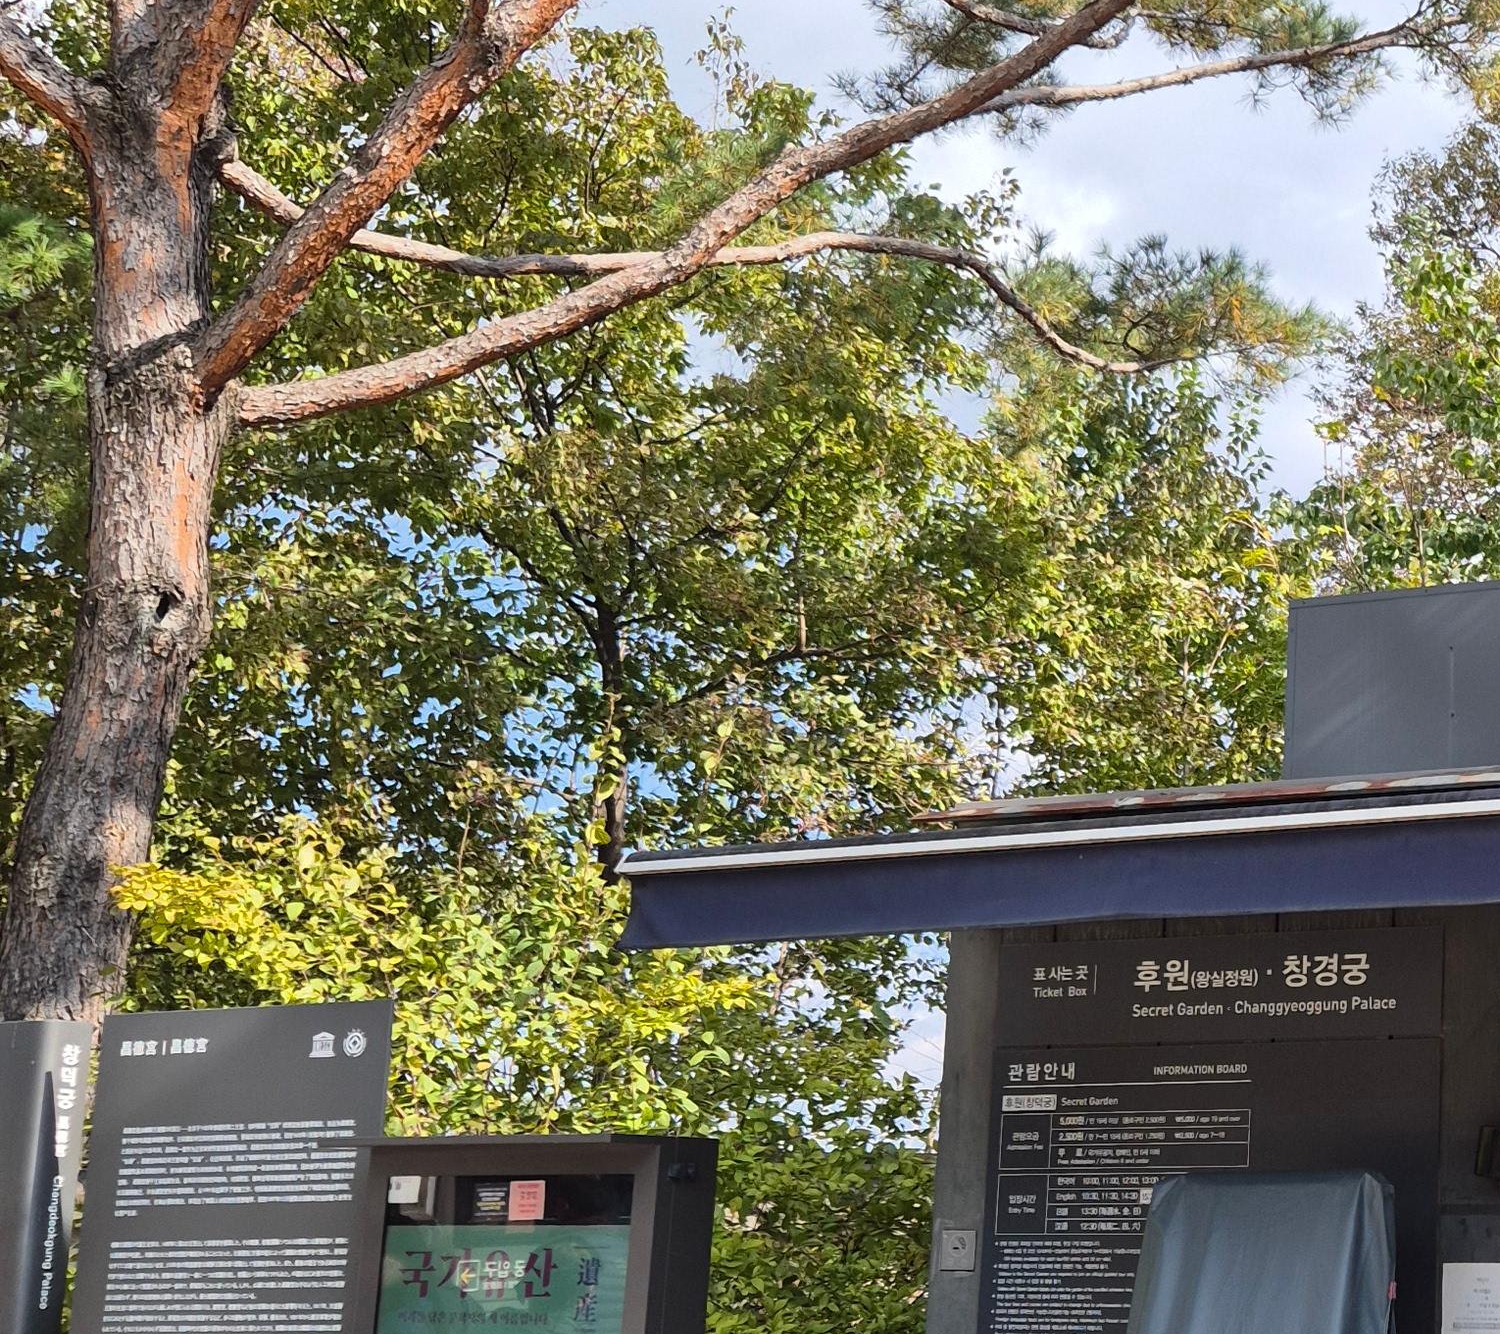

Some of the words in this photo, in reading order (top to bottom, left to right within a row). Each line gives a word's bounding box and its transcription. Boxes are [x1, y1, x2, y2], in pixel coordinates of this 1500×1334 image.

[1033, 966, 1047, 981] 표
[1075, 965, 1089, 981] 곳
[1282, 953, 1371, 987] 창경궁
[1033, 985, 1063, 999] Ticket
[1068, 985, 1087, 997] Box
[1132, 1003, 1174, 1018] Secret
[1177, 1002, 1224, 1017] Garden
[1351, 996, 1397, 1010] Palace
[1008, 1061, 1076, 1082] 관람안내
[1153, 1064, 1214, 1076] INFORMATION
[1216, 1063, 1247, 1075] BOARD
[1061, 1097, 1088, 1107] Secret
[1089, 1096, 1119, 1106] Garden
